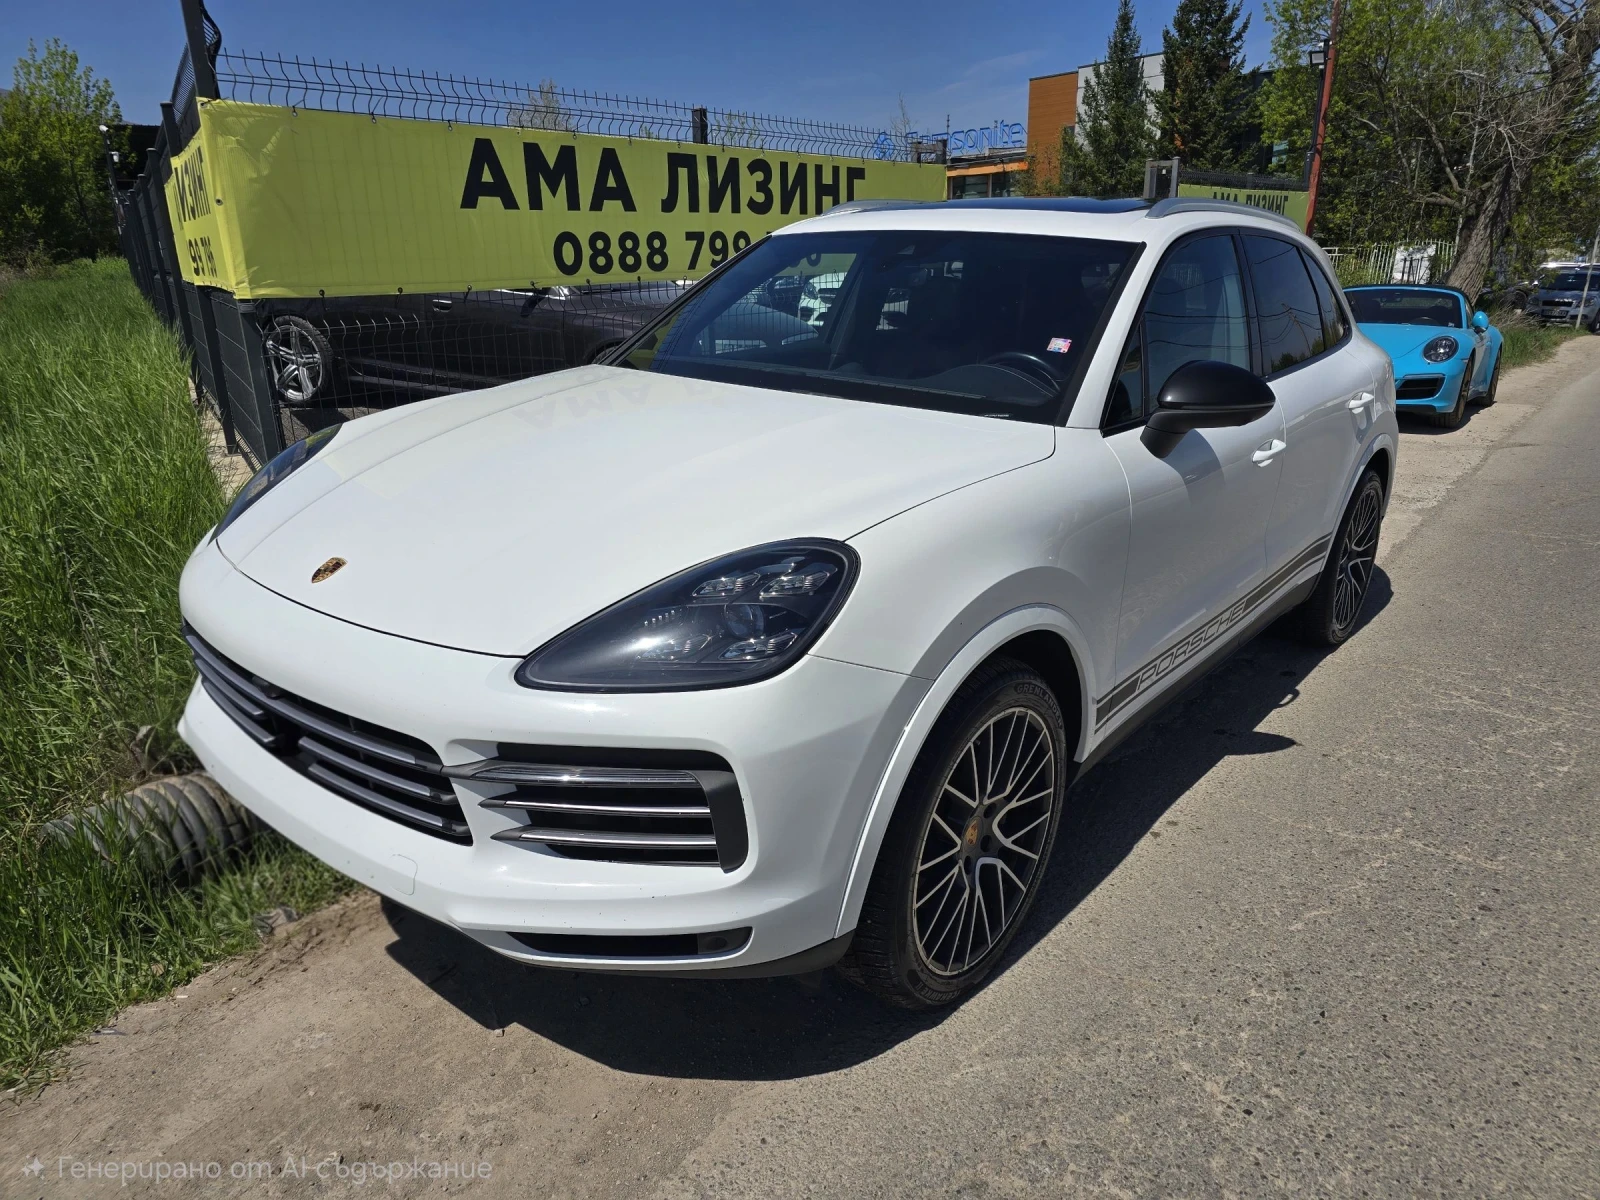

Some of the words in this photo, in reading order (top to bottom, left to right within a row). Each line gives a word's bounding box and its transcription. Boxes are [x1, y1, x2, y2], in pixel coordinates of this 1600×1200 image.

[460, 137, 637, 213] АМА
[660, 152, 866, 216] ЛИЗИНГ
[553, 230, 669, 276] 0888
[1137, 600, 1245, 691] PORSCHE
[1017, 684, 1062, 728] GRENLANDER
